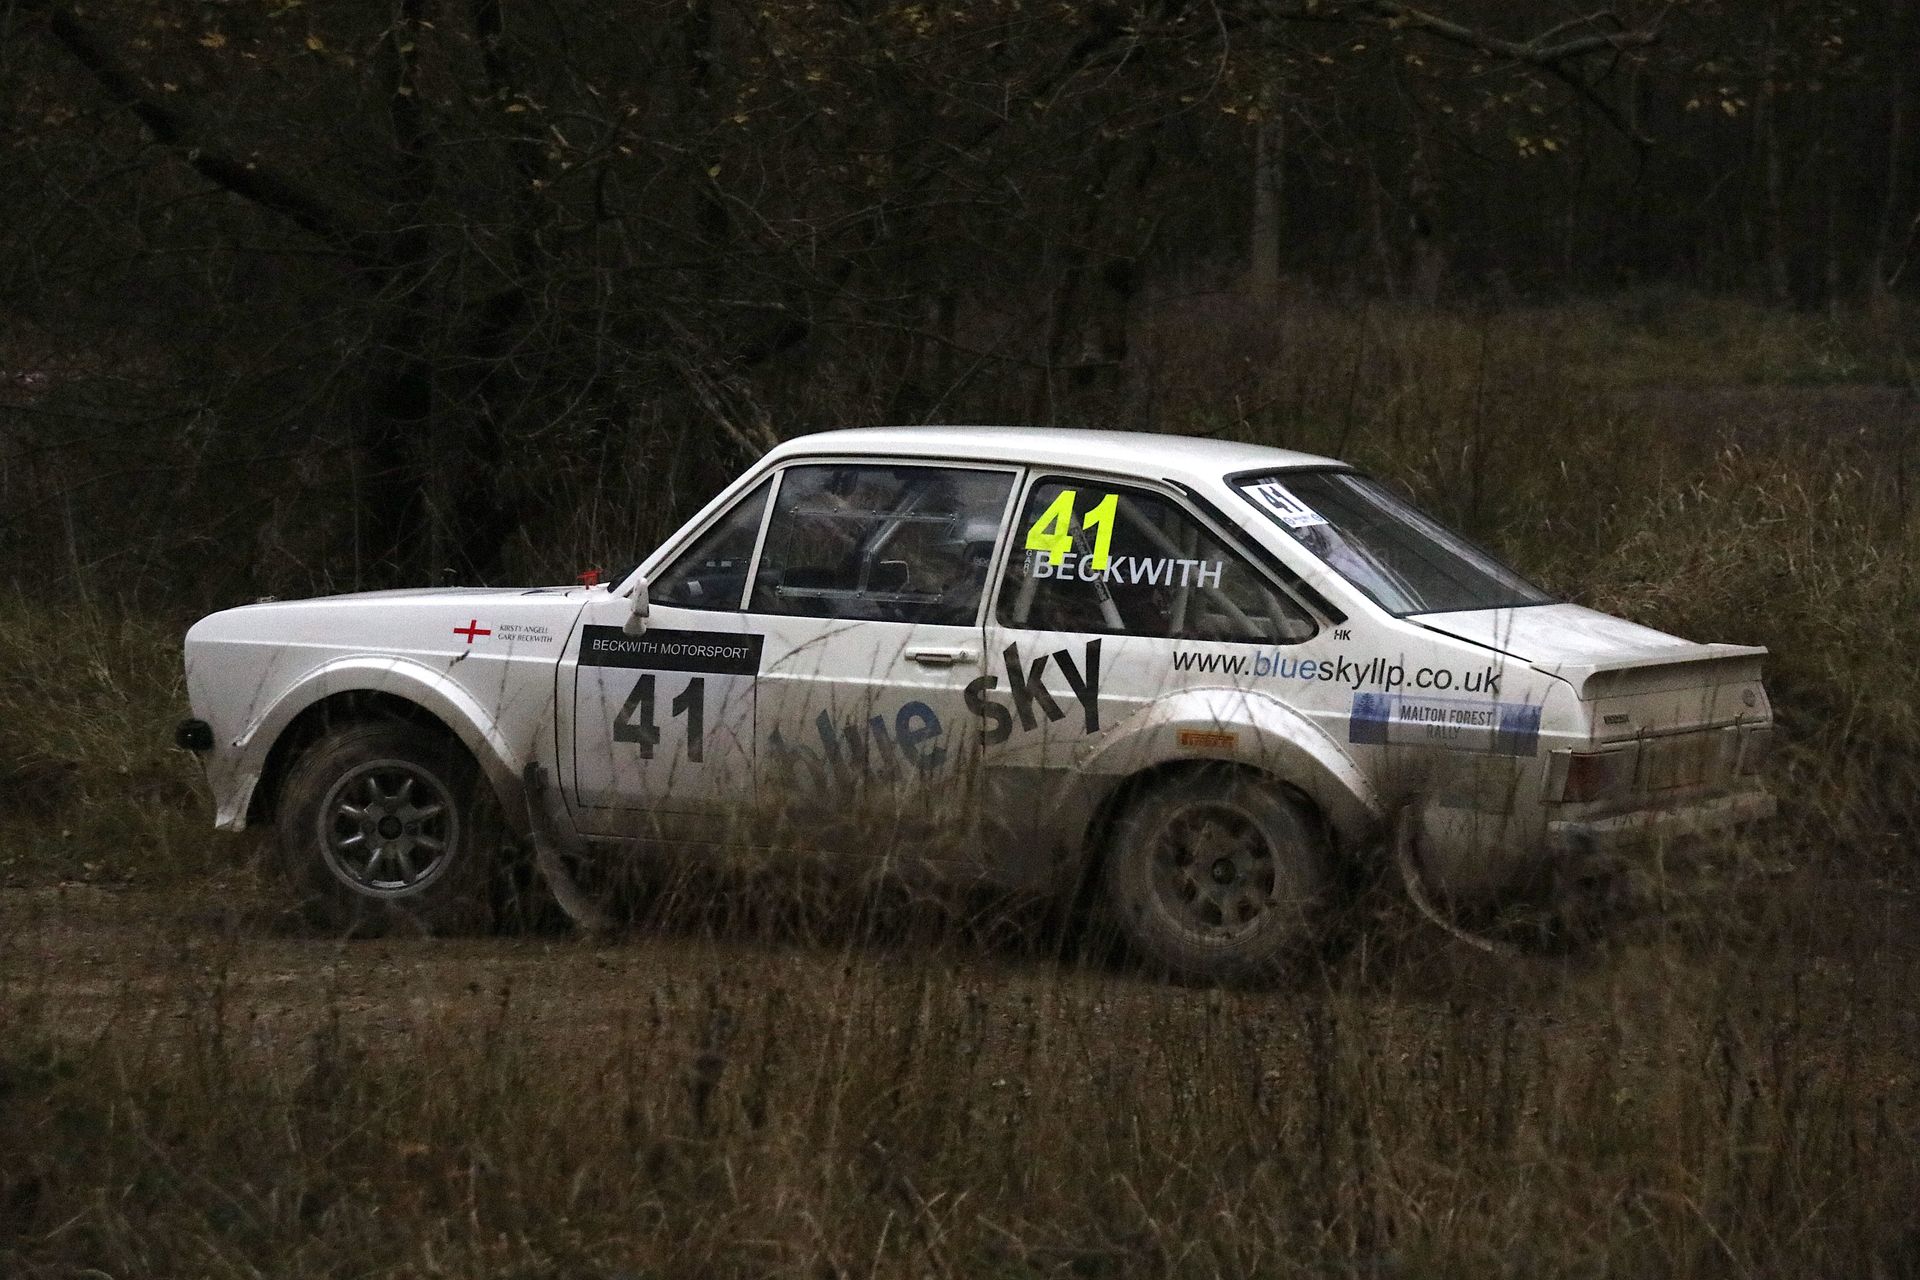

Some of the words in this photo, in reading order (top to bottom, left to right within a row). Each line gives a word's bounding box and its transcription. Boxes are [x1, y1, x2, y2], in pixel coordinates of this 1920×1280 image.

[1257, 485, 1304, 514] 41
[1025, 490, 1119, 570] 41
[1033, 550, 1222, 588] BECKWITH
[498, 633, 516, 641] GARY
[517, 634, 553, 643] BECKWITH
[499, 624, 523, 632] KIRSTY
[524, 626, 548, 634] ANGELL
[1333, 629, 1352, 641] HK
[592, 638, 658, 654] BECKWITH
[660, 642, 750, 659] MOTORSPORT
[1173, 650, 1500, 692] www.blueskyllp.co.uk
[964, 638, 1102, 747] sky
[613, 674, 705, 763] 41
[1400, 704, 1446, 723] MALTON
[1449, 710, 1494, 727] FOREST
[1425, 724, 1462, 740] RALLY
